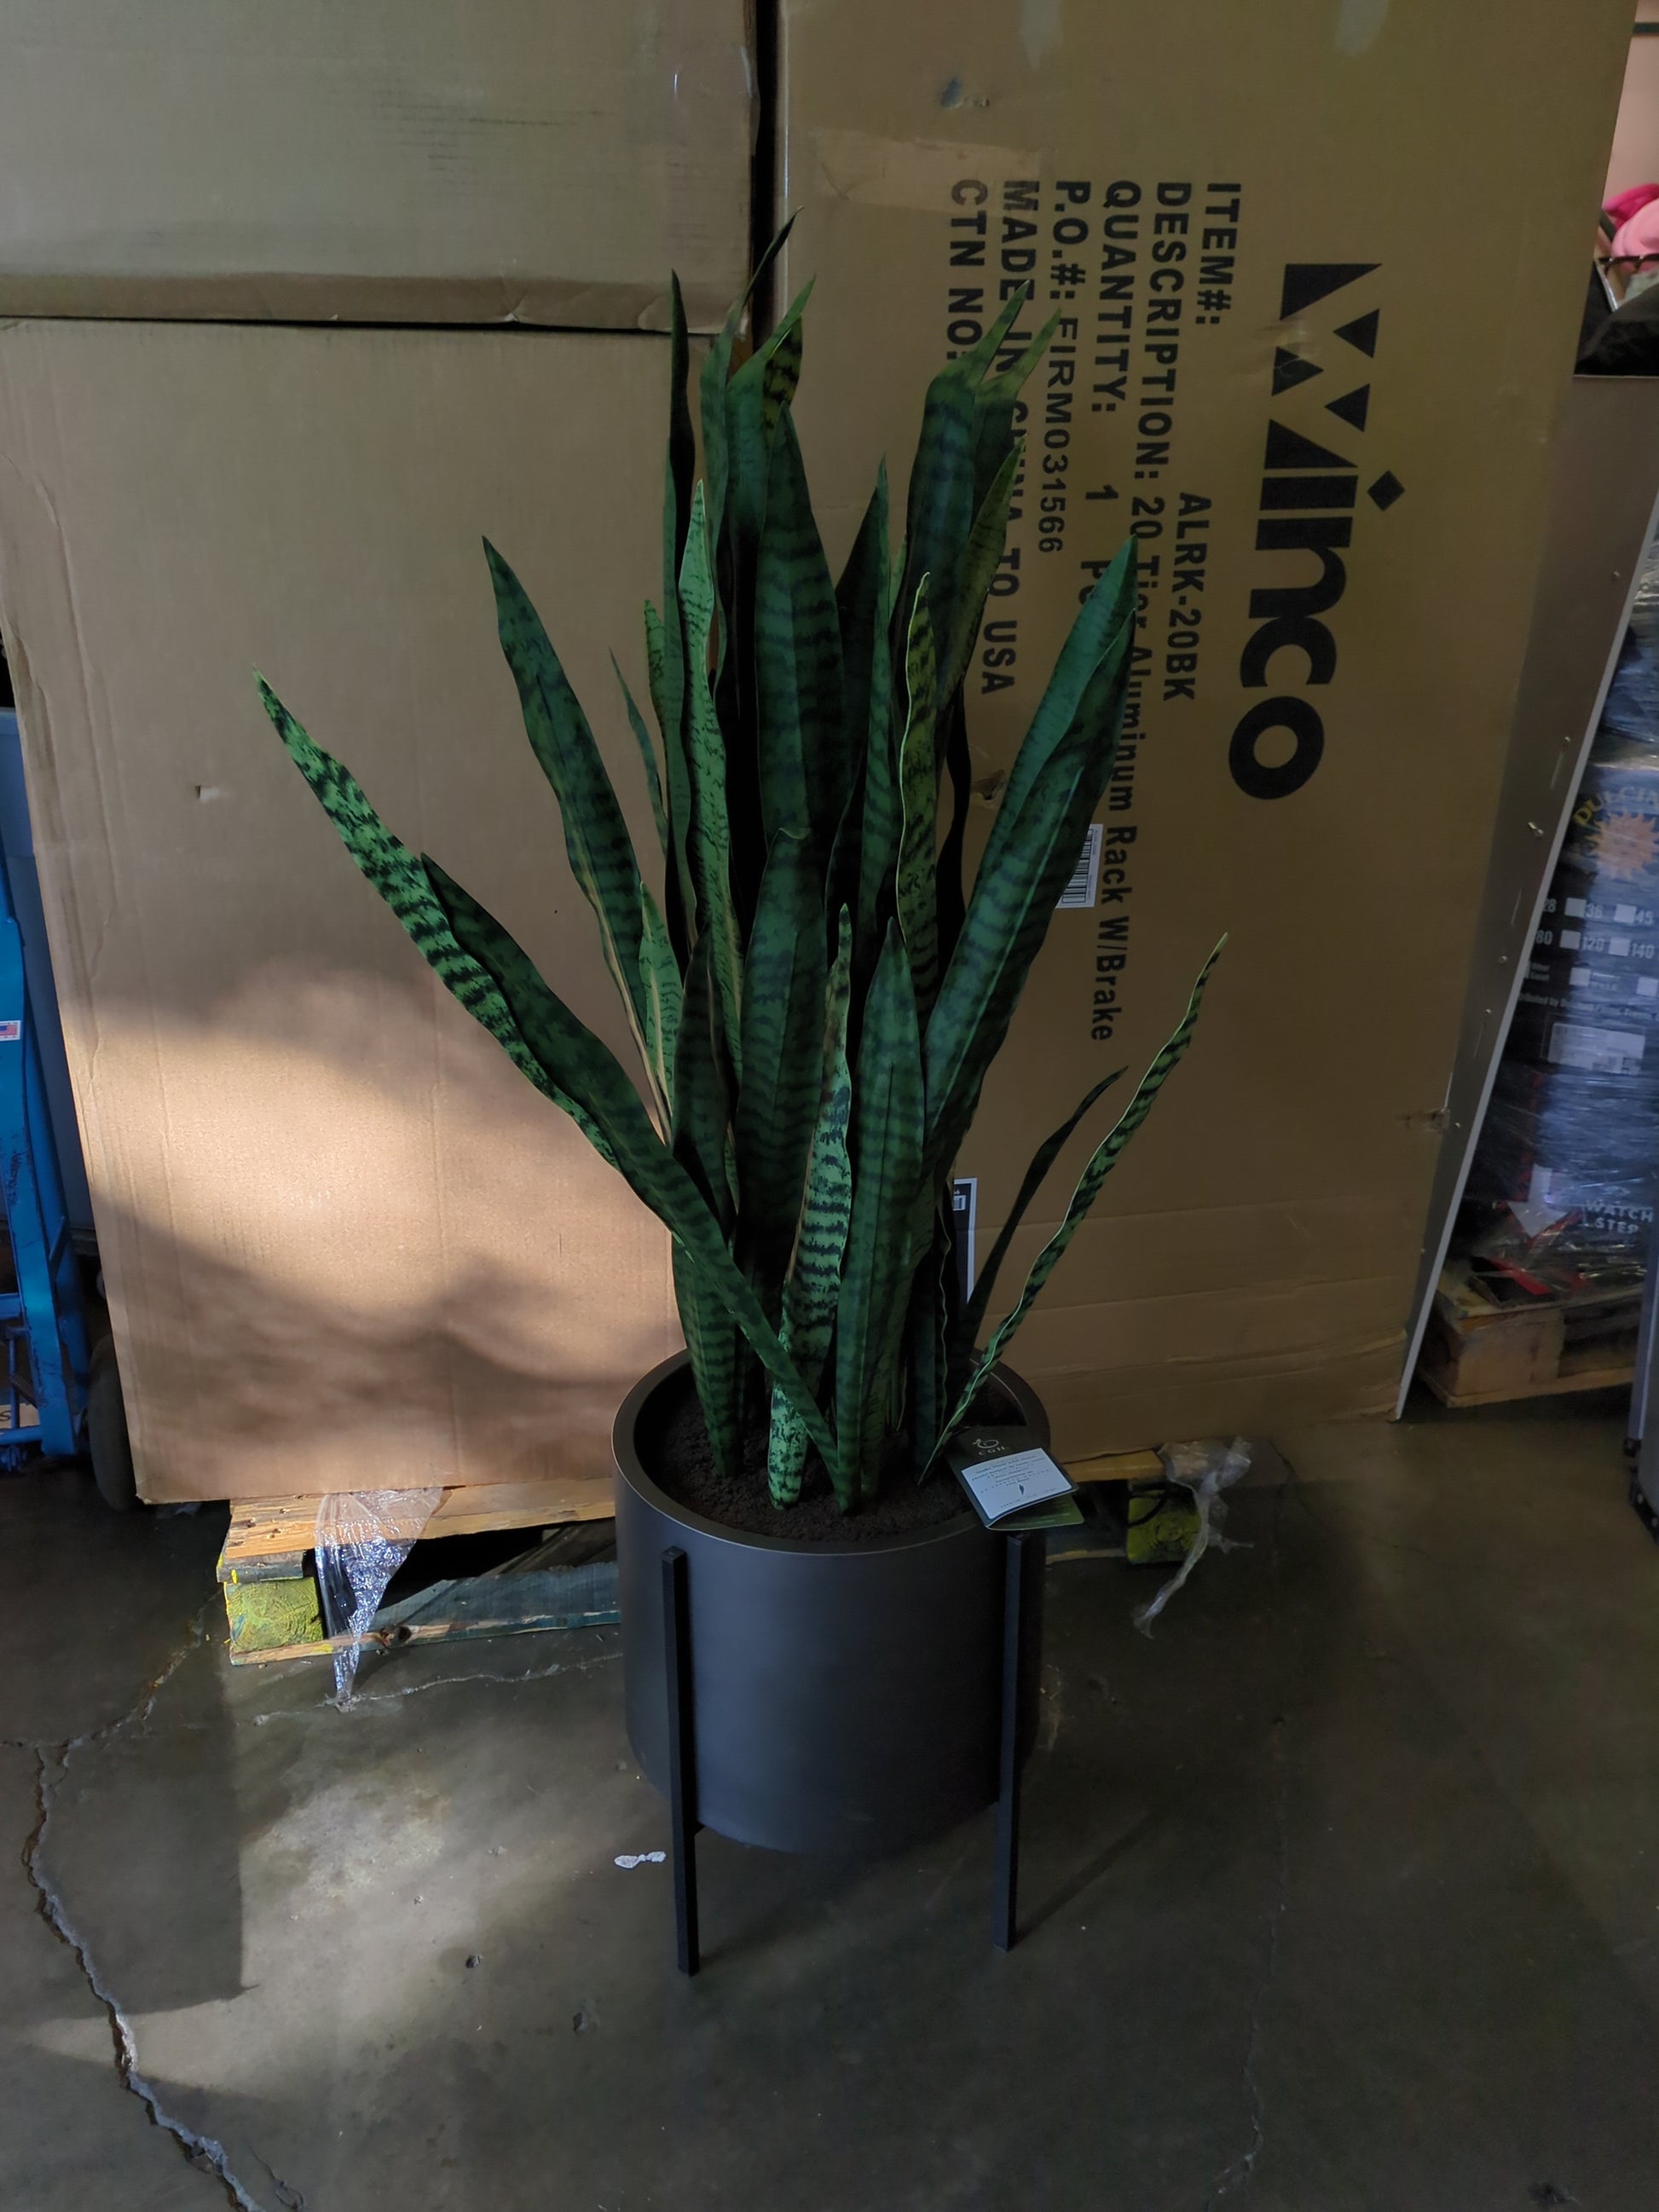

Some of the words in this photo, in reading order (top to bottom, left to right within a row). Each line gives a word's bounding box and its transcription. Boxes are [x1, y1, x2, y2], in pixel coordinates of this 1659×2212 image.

[950, 179, 988, 266] CTN
[999, 181, 1040, 301] MADE
[1049, 181, 1091, 299] P.O.#:
[1196, 183, 1241, 325] ITEM#:
[1091, 180, 1142, 413] QUANTITY:
[1135, 182, 1192, 479] DESCRIPTION:
[1038, 318, 1078, 553] FIRM031566
[1085, 485, 1119, 502] 1
[1130, 496, 1165, 540] 20
[987, 548, 1020, 596] TO
[1163, 492, 1212, 701] ALRK-20BK
[981, 620, 1017, 694] USA
[1101, 825, 1137, 904] Rack
[1582, 936, 1604, 952] 120
[1632, 943, 1655, 959] 140
[1586, 903, 1603, 918] 36
[1635, 910, 1654, 925] 45
[1091, 915, 1130, 1041] W/Brake
[1585, 1200, 1654, 1222] WATCH
[1595, 1217, 1639, 1234] STEP
